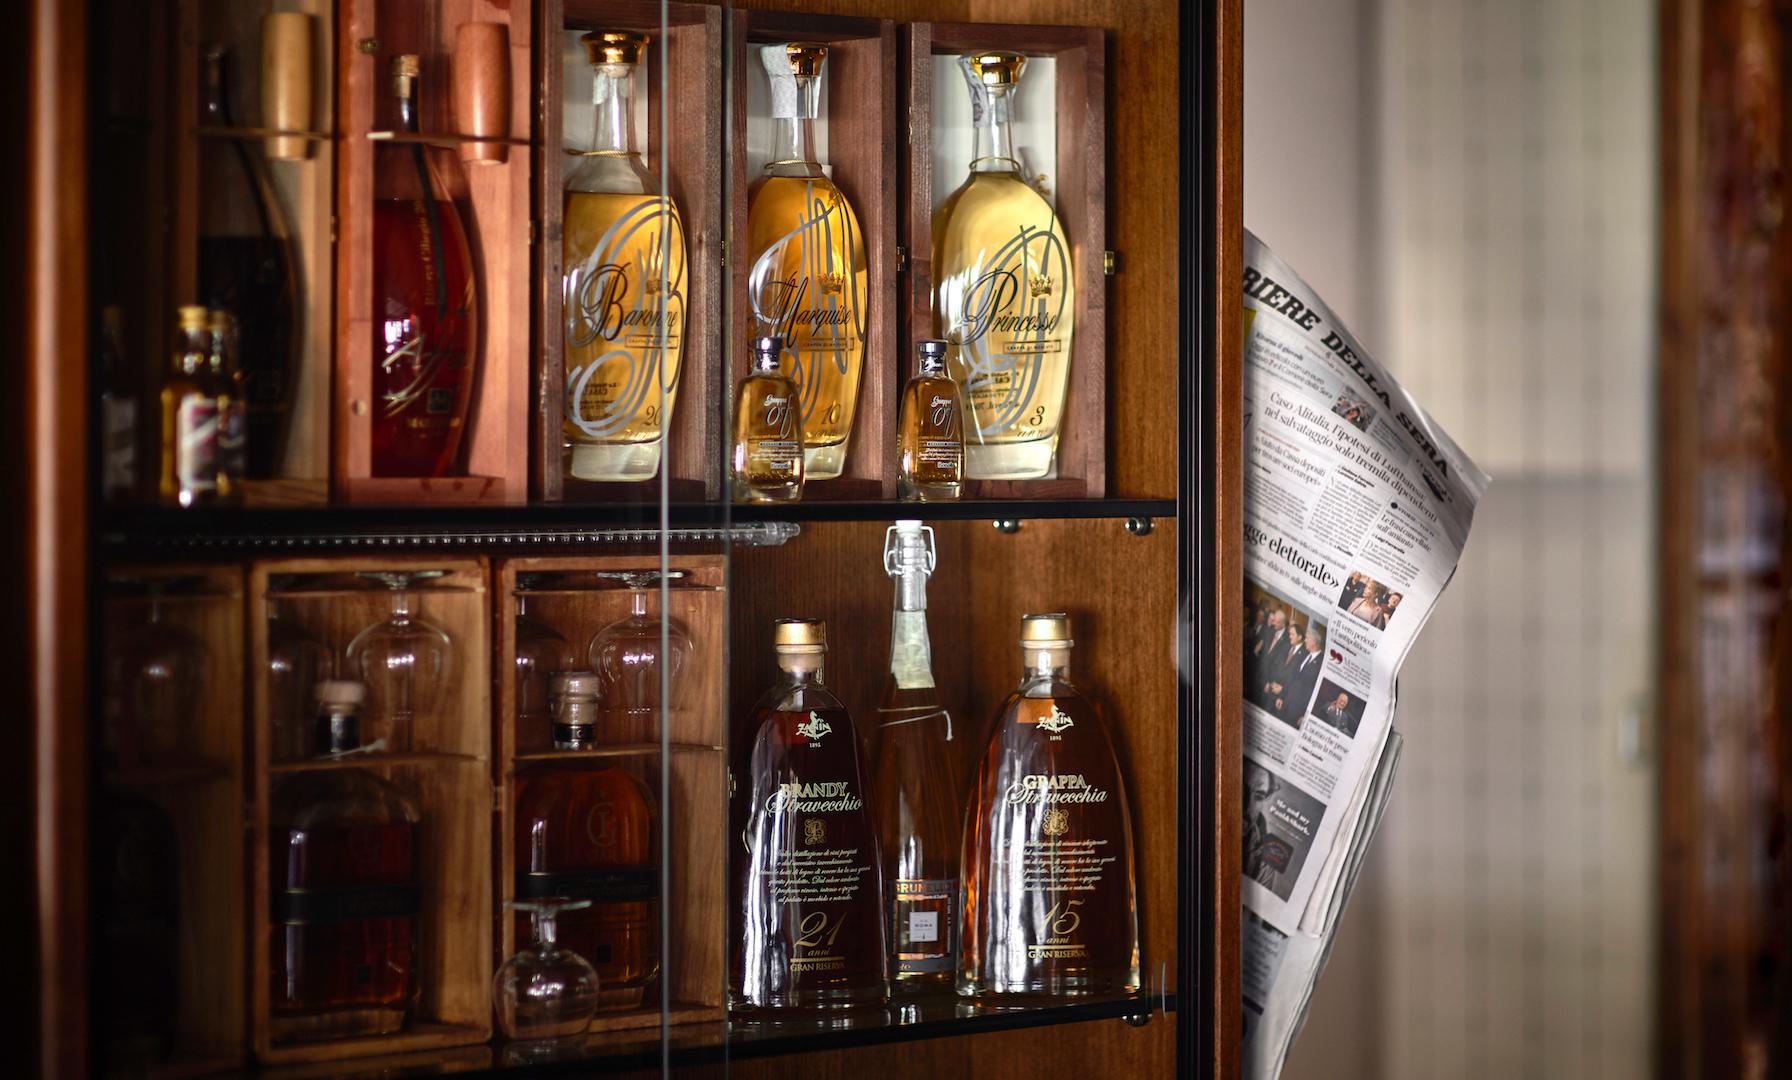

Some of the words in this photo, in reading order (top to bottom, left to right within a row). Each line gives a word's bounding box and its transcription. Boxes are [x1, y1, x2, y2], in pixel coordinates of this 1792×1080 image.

[760, 271, 851, 347] Marquise
[957, 263, 1057, 345] Princesse
[821, 403, 841, 425] 10
[1321, 330, 1392, 410] DELLA
[1397, 411, 1449, 478] SERA
[1030, 405, 1045, 427] 3
[1269, 391, 1293, 409] Caso
[1295, 405, 1332, 431] Alitalia,
[1330, 424, 1370, 454] l'ipotesi
[1369, 449, 1382, 461] di
[1263, 404, 1282, 419] nel
[1278, 412, 1335, 449] salvataggio
[1333, 440, 1357, 460] solo
[1355, 453, 1393, 483] tremila
[1390, 478, 1440, 522] dipendenti
[1299, 458, 1326, 476] depositi
[1269, 537, 1340, 589] elettorale»
[1353, 632, 1378, 648] pericolo
[780, 782, 848, 798] BRANDY
[1023, 774, 1088, 790] GRAPPA
[765, 792, 863, 817] Stravecchio
[1005, 783, 1107, 808] Stravecchia
[1041, 898, 1086, 935] 15
[793, 911, 848, 948] 21
[1046, 935, 1071, 944] anni
[807, 947, 830, 957] anni
[1028, 950, 1053, 959] GRAN
[1054, 949, 1087, 959] RISERVA
[790, 963, 814, 972] GRAN
[815, 962, 846, 971] RISERVA
